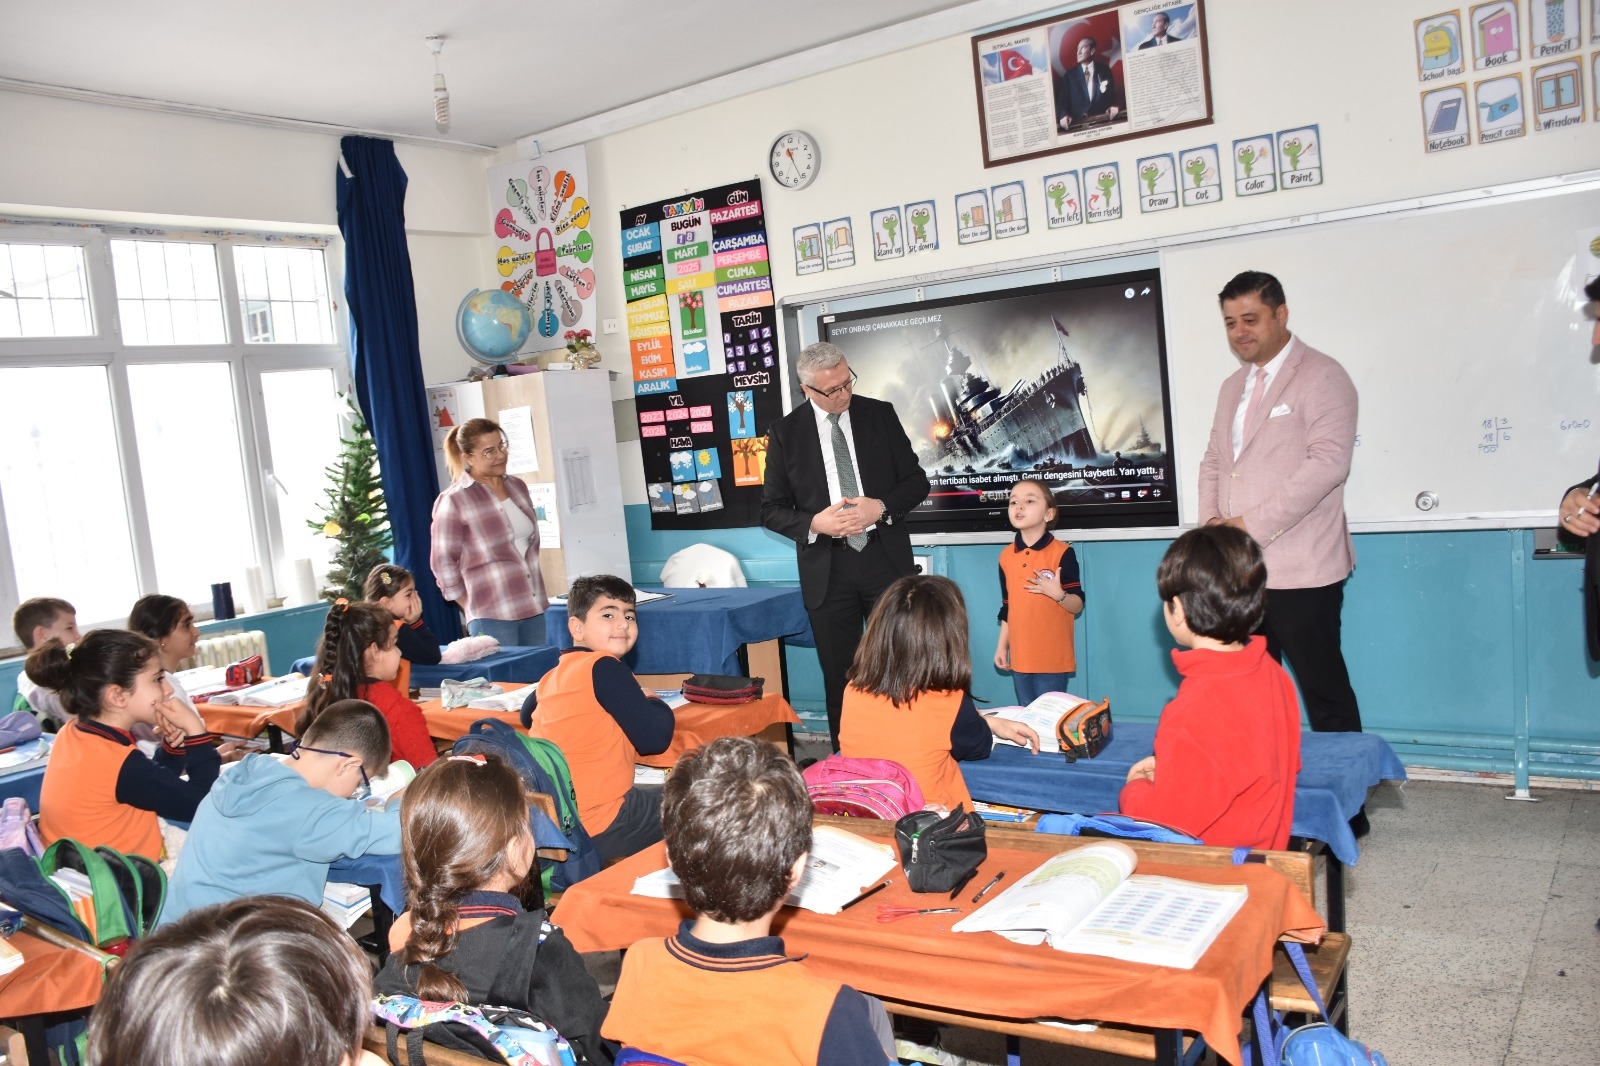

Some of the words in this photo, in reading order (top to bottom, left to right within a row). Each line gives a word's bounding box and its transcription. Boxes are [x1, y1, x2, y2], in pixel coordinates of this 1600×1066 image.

[1540, 41, 1571, 56] Pencil
[1485, 52, 1508, 67] Book
[1423, 71, 1445, 82] School
[1446, 67, 1462, 77] bag
[1543, 116, 1580, 130] Window
[1481, 130, 1502, 141] Pencil
[1504, 127, 1522, 136] case
[1430, 136, 1464, 150] Notebook
[1290, 172, 1313, 184] Paint
[1245, 180, 1266, 191] Color
[727, 190, 748, 206] GÜN
[1196, 190, 1209, 200] Cut
[663, 197, 704, 218] TAKVİM
[1148, 197, 1169, 208] Draw
[711, 204, 759, 223] PAZARTESİ
[1050, 216, 1065, 224] Turn
[1066, 212, 1080, 222] left
[1104, 206, 1120, 217] right
[635, 214, 646, 226] AY
[671, 216, 701, 231] BUGÜN
[556, 221, 569, 233] Rica
[626, 226, 651, 240] OCAK
[627, 240, 652, 256] ŞUBAT
[712, 234, 765, 252] ÇARŞAMBA
[908, 245, 917, 253] Sit
[918, 242, 934, 250] down
[674, 246, 699, 260] MART
[717, 249, 761, 265] PERŞEMBE
[630, 266, 656, 282] NİSAN
[677, 263, 699, 274] 2025
[727, 266, 756, 279] CUMA
[566, 271, 586, 287] Lütfen
[678, 278, 696, 290] SALI
[631, 283, 656, 296] MAYIS
[718, 278, 770, 296] CUMARTESİ
[558, 286, 575, 318] Merhaba
[729, 296, 760, 308] PAZAR
[630, 310, 664, 323] TEMMUZ
[732, 312, 762, 327] TARİH
[630, 324, 669, 338] AĞUSTOS
[832, 326, 847, 336] SEYİT
[849, 325, 871, 334] ONBAŞI
[872, 318, 909, 331] ÇANAKKALE
[910, 315, 942, 326] GEÇİLMEZ
[752, 330, 757, 338] 1
[764, 329, 770, 337] 2
[637, 339, 662, 352] EYLÜL
[727, 349, 733, 357] 2
[737, 347, 742, 355] 3
[750, 344, 757, 353] 4
[764, 344, 770, 352] 5
[641, 353, 661, 364] EKİM
[640, 367, 667, 379] KASIM
[728, 364, 735, 372] 6
[739, 362, 744, 370] 7
[734, 372, 770, 387] MEVSİM
[638, 381, 670, 394] ARALIK
[669, 395, 684, 406] YIL
[643, 412, 663, 421] 2023
[668, 409, 687, 420] 2024
[691, 407, 711, 416] 2027
[692, 422, 712, 432] 2028
[1482, 420, 1492, 430] 18
[670, 437, 692, 448] HAVA
[1503, 432, 1511, 441] 6
[940, 476, 968, 486] tertibatı
[969, 475, 992, 484] isabet
[993, 473, 1021, 484] almıştı.
[1022, 472, 1042, 480] Gemi
[1044, 470, 1082, 480] dengesini
[1084, 468, 1117, 479] kaybetti.
[1119, 467, 1136, 476] Yan
[1137, 466, 1158, 476] yattı.
